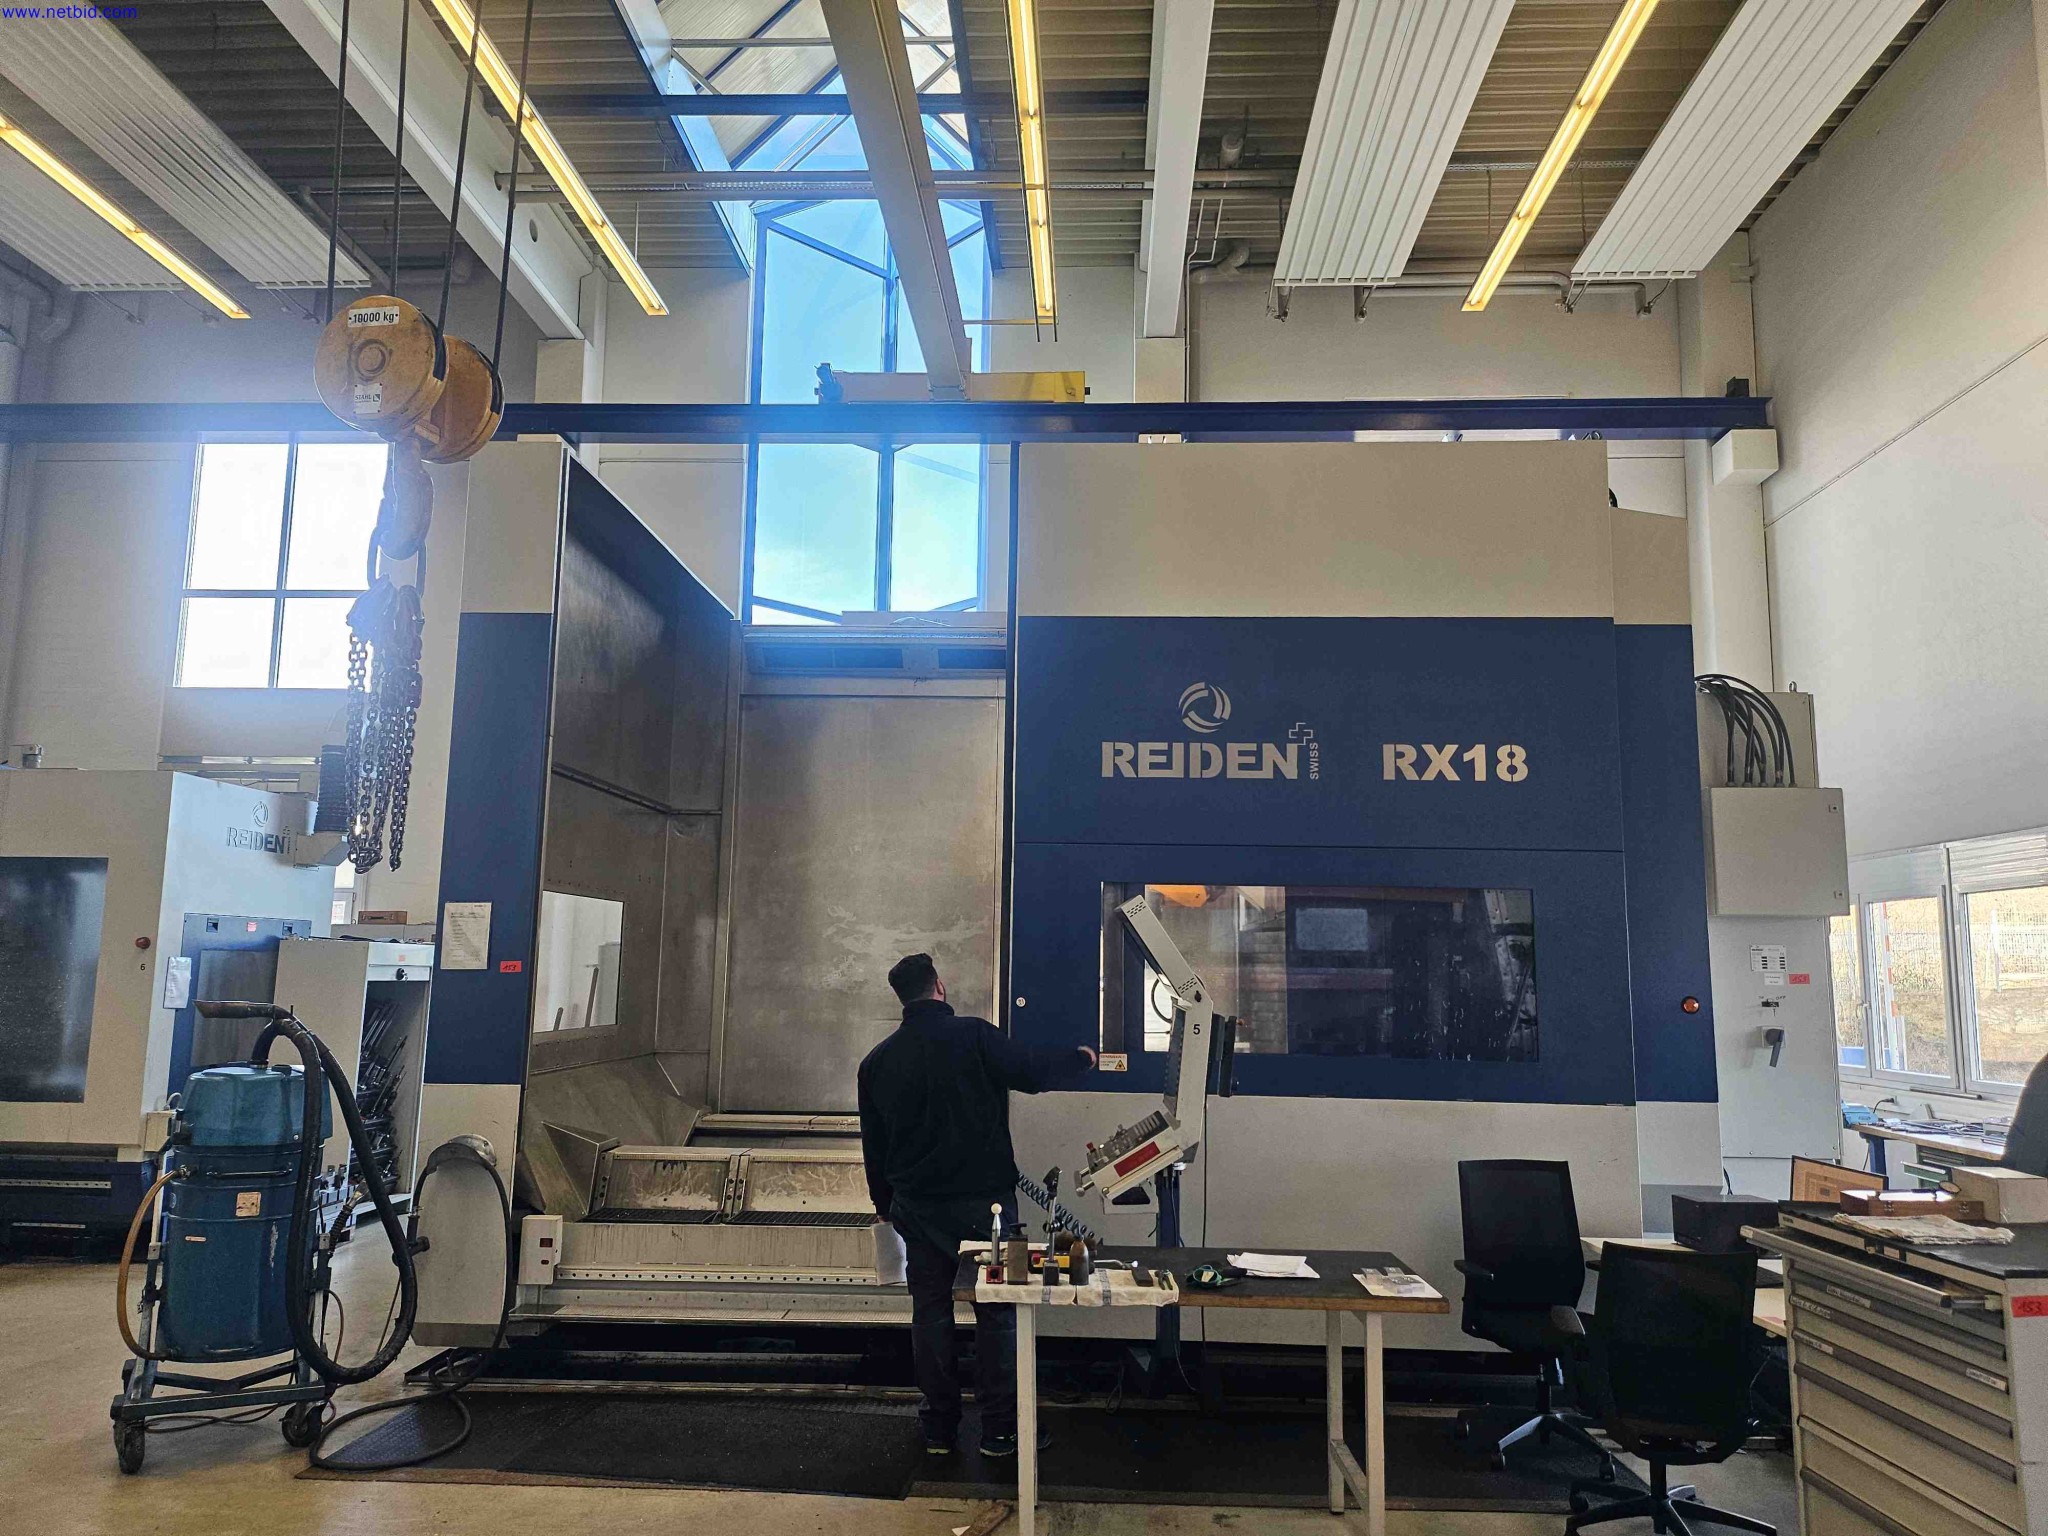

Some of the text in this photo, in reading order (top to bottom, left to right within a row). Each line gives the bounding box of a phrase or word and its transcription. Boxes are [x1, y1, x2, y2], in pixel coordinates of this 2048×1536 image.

[383, 311, 395, 323] kg
[1101, 741, 1298, 780] REIDEN
[1309, 742, 1319, 780] SWISS
[1382, 743, 1529, 782] RX18
[226, 827, 286, 854] REIDEN
[140, 963, 146, 971] 6
[1193, 1023, 1201, 1035] 5
